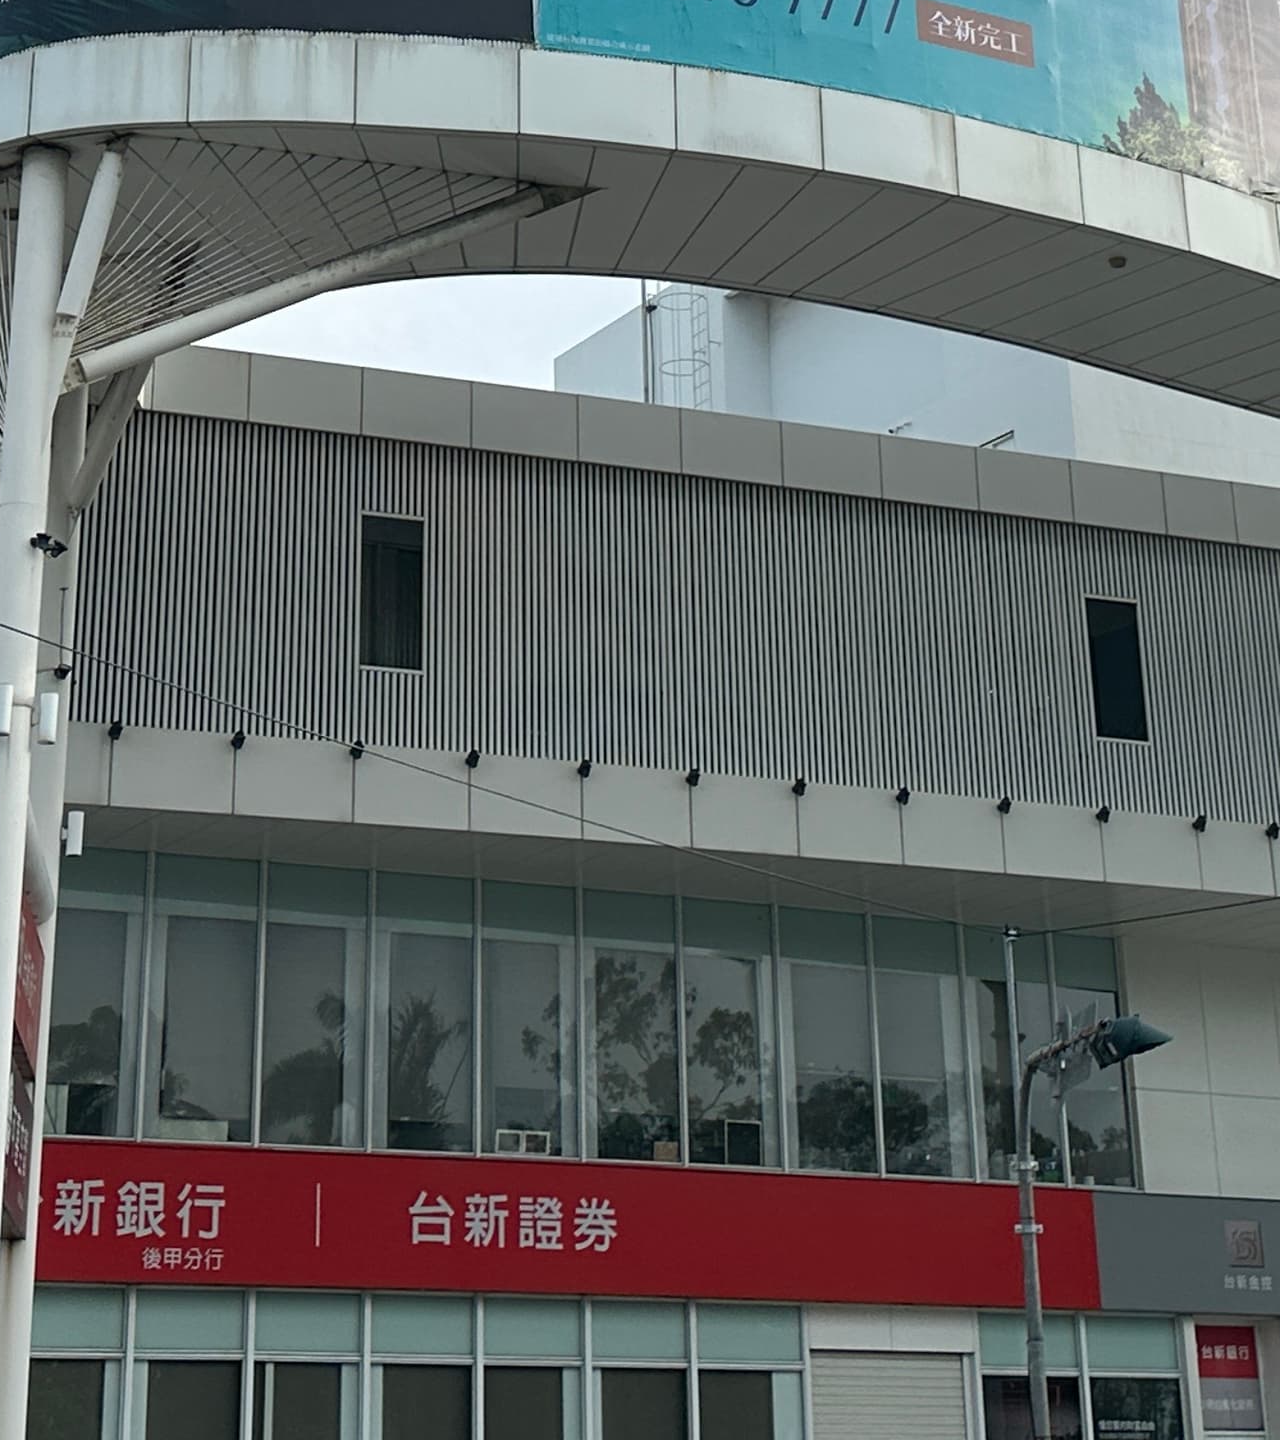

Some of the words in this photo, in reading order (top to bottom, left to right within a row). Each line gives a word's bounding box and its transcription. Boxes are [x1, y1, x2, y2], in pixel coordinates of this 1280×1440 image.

[929, 9, 1028, 57] 全新完工
[40, 1178, 226, 1240] 新銀行
[408, 1190, 618, 1253] 台新證券
[141, 1247, 225, 1271] 後甲分行
